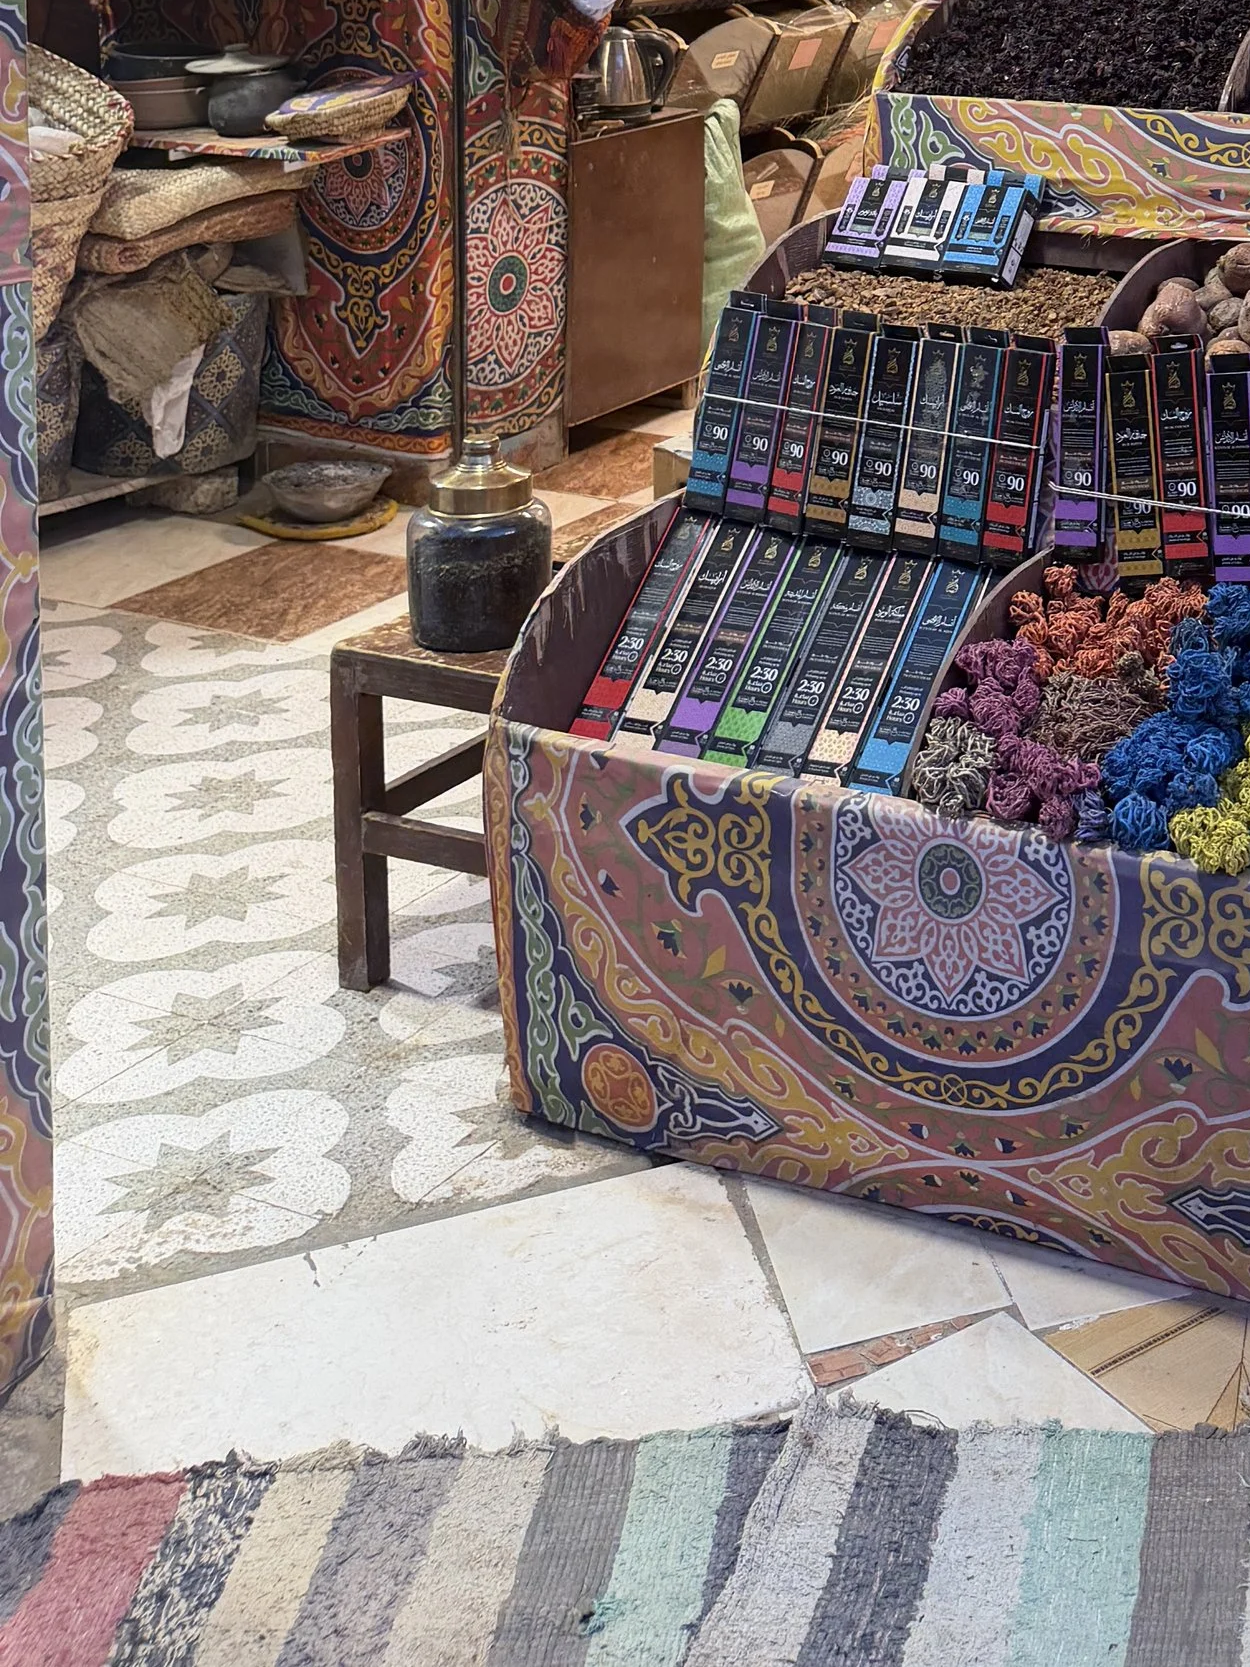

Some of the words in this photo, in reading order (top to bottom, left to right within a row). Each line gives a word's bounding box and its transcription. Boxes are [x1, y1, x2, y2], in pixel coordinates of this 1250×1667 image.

[712, 426, 728, 441] 90
[752, 436, 768, 451] 90
[790, 443, 804, 458] 90
[832, 450, 848, 465] 90
[874, 461, 892, 476] 90
[920, 464, 936, 479] 90
[962, 470, 980, 486] 90
[1007, 476, 1024, 492] 90
[1074, 472, 1092, 486] 90
[1178, 482, 1196, 496] 90
[1133, 502, 1151, 516] 90
[1232, 504, 1250, 517] 90
[618, 636, 644, 650] 2:30
[661, 648, 688, 663] 2:30
[705, 656, 732, 672] 2:30
[750, 666, 778, 681] 2:30
[797, 679, 825, 694] 2:30
[842, 686, 870, 701] 2:30
[892, 696, 920, 711] 2:30
